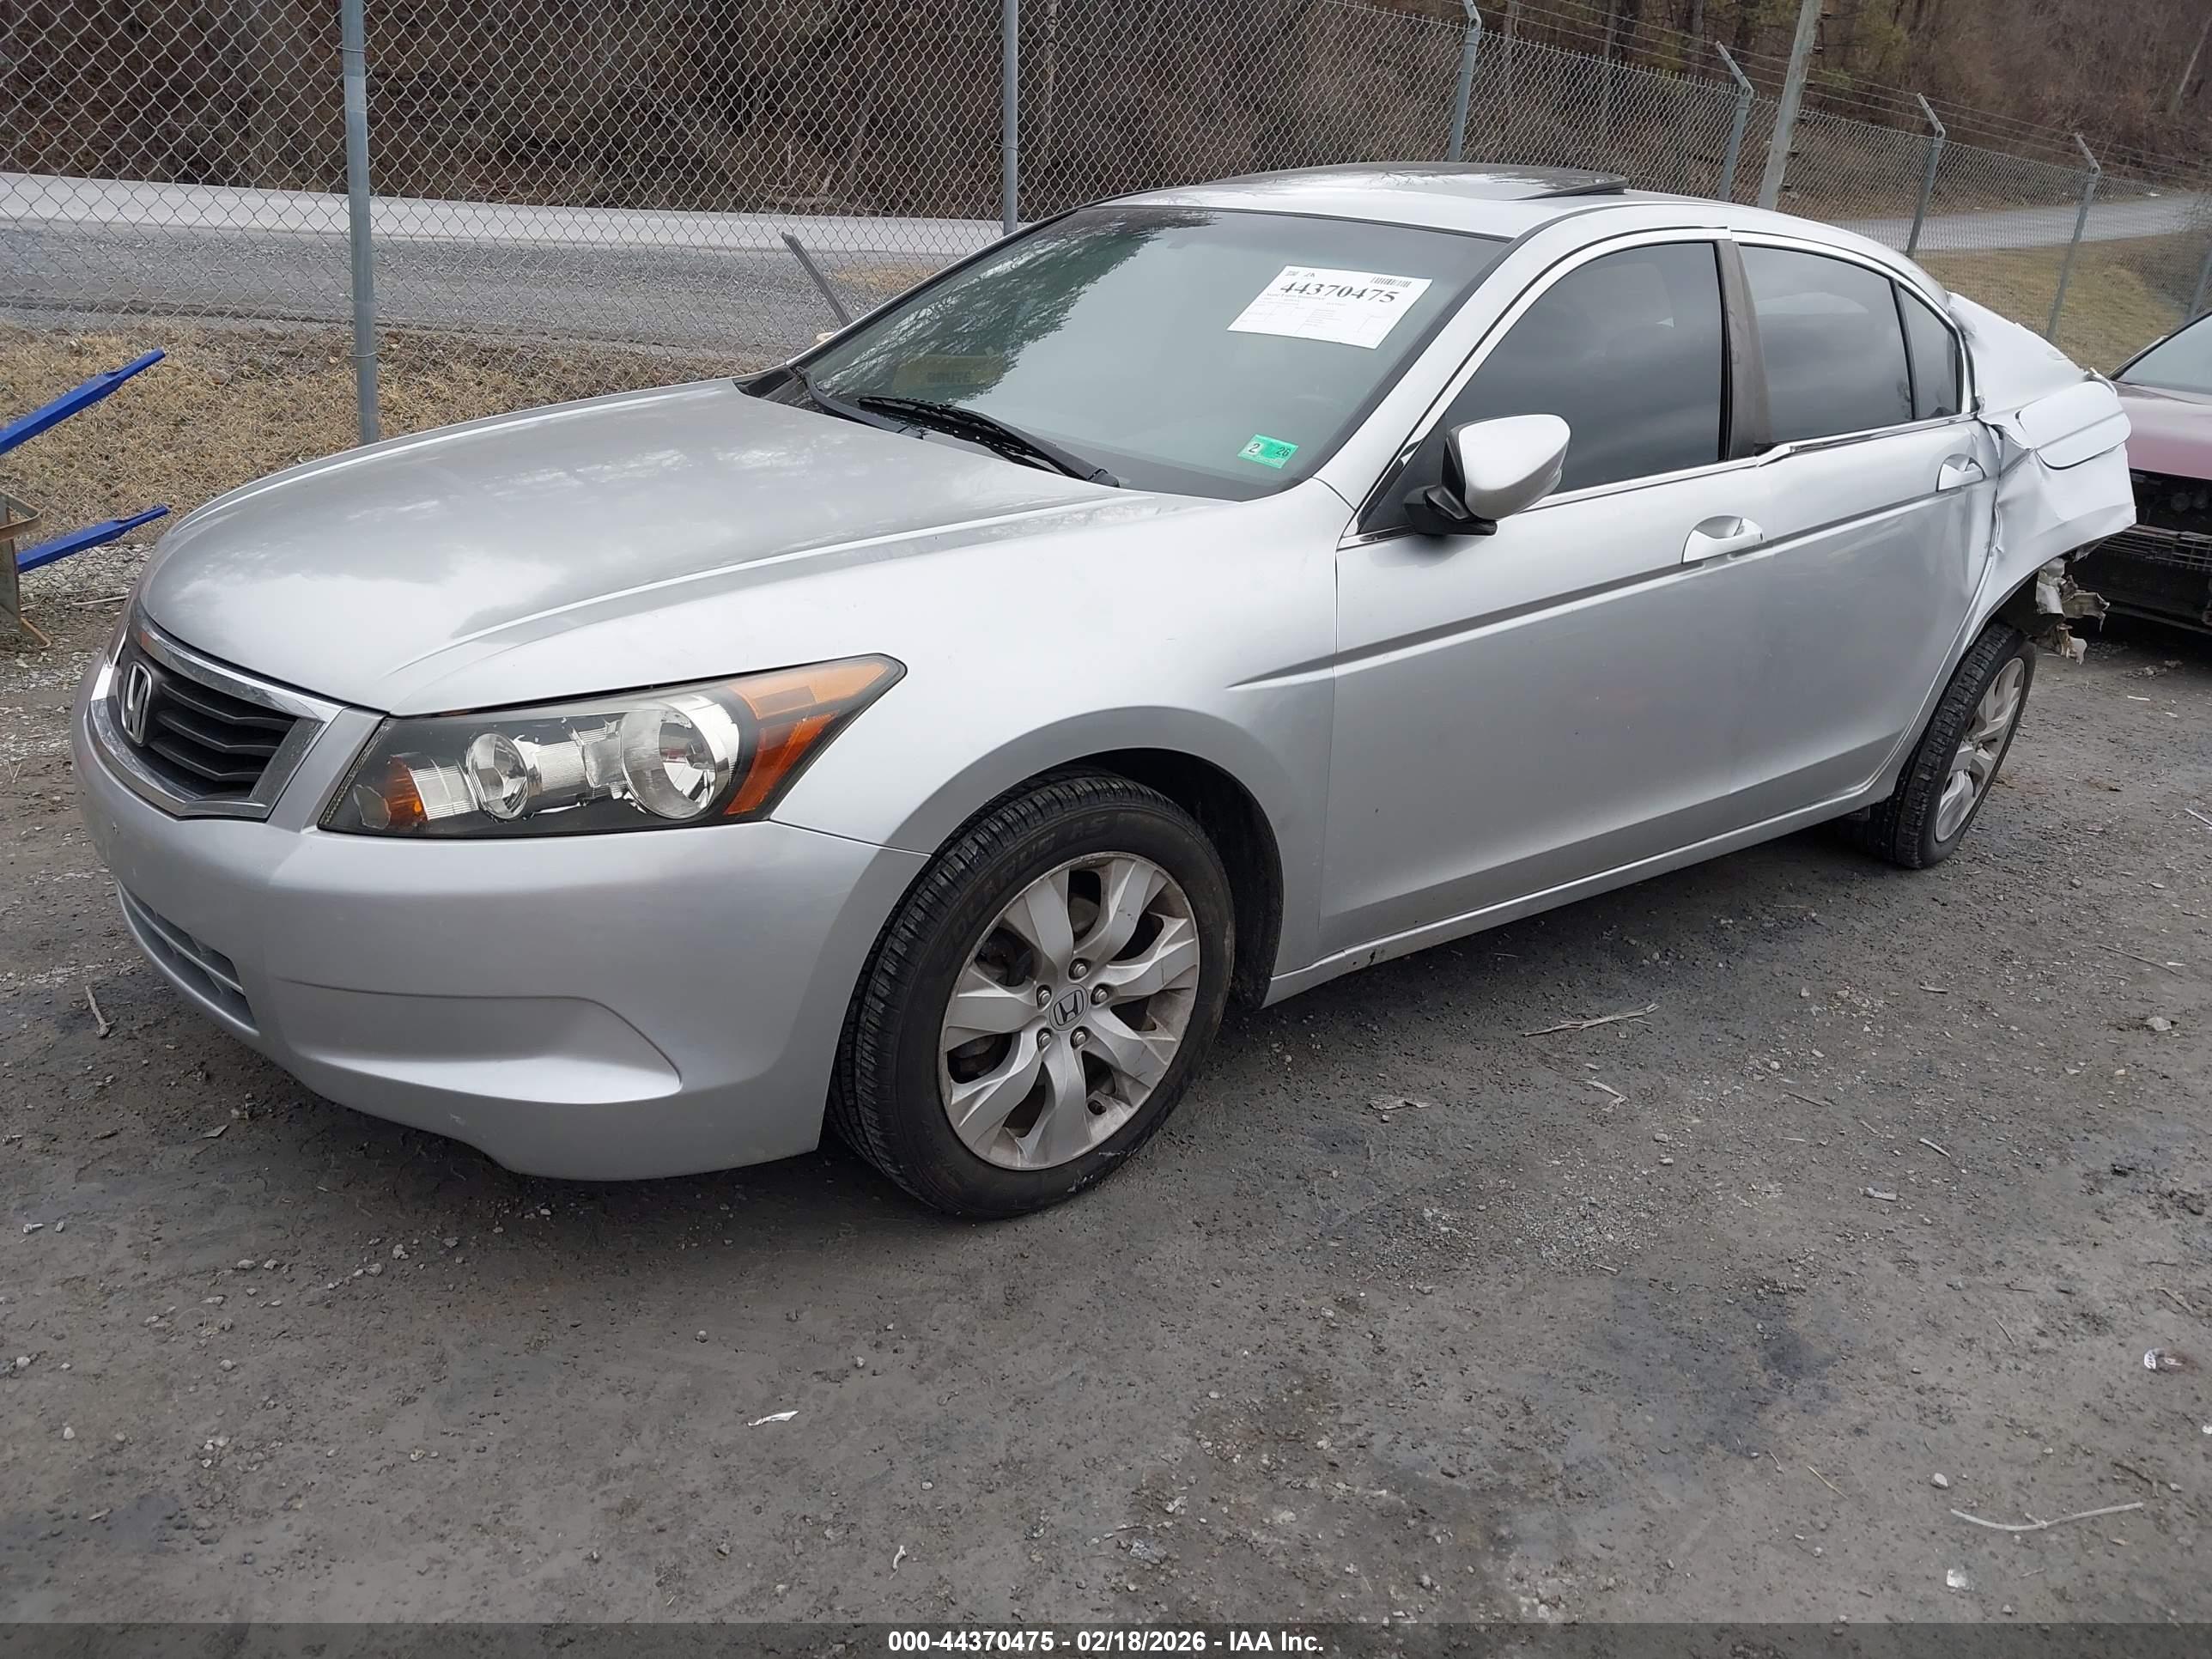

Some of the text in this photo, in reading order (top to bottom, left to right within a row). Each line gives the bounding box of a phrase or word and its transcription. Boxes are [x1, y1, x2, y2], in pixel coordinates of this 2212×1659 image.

[1280, 281, 1400, 304] 44370475
[1249, 442, 1291, 458] 2 26
